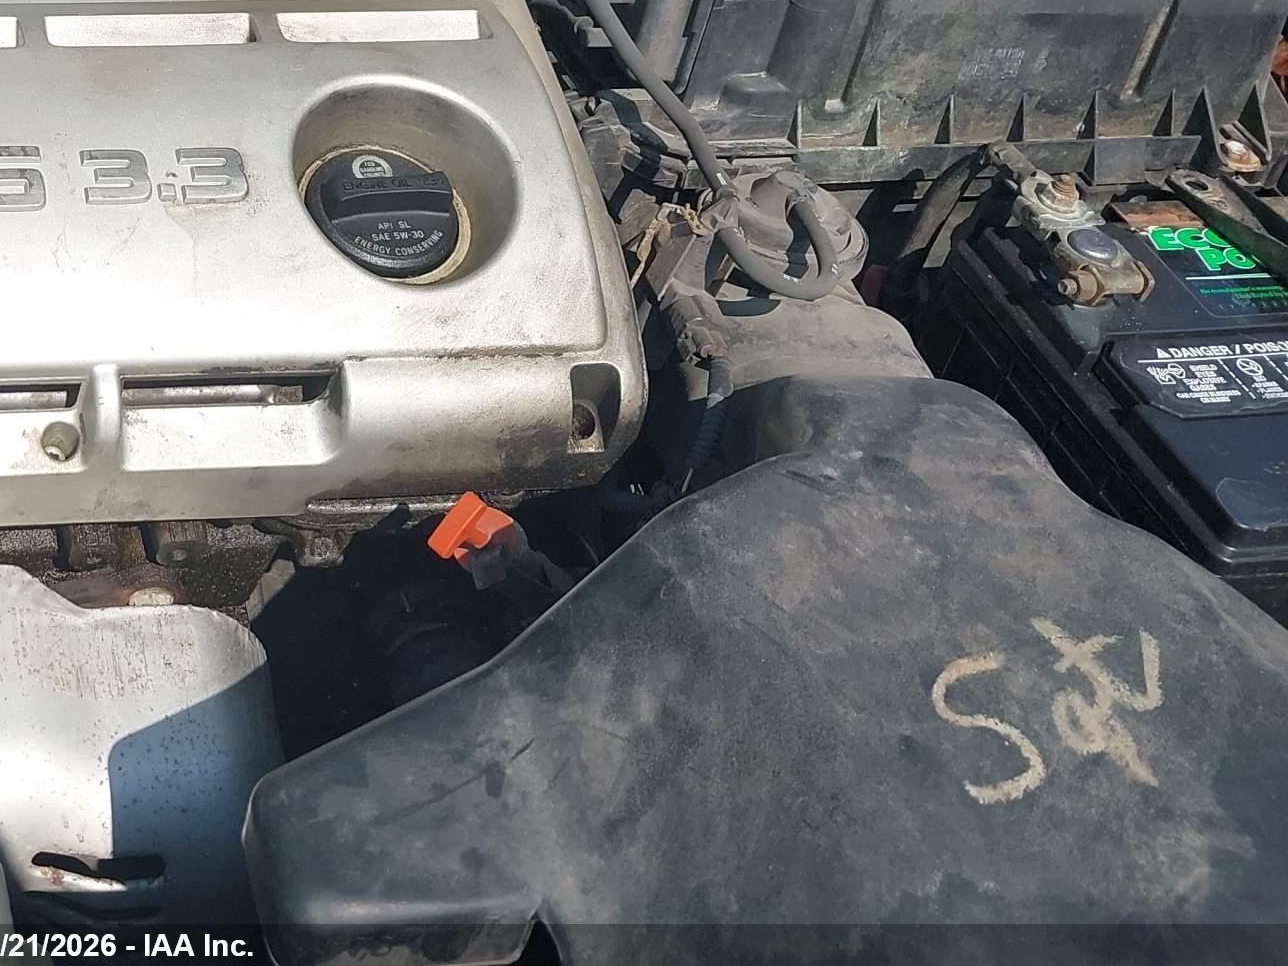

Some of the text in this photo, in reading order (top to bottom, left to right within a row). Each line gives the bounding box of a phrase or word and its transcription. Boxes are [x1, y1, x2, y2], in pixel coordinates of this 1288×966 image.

[78, 144, 251, 207] 3.3
[378, 221, 411, 230] API SL
[354, 230, 443, 256] ENERGY CONSERVING
[372, 230, 425, 242] SAE 5W-30
[1168, 345, 1234, 359] DANGER
